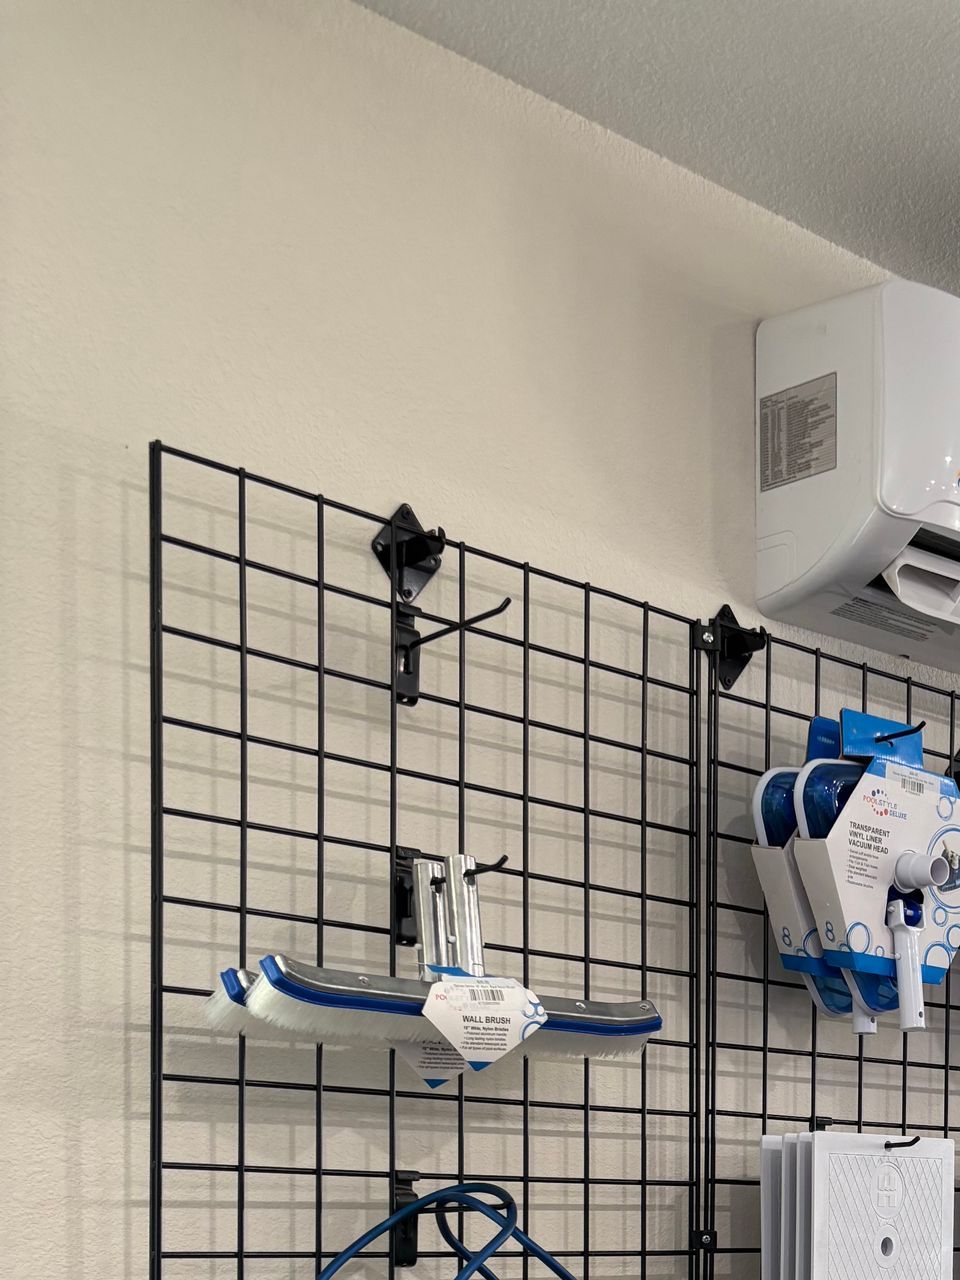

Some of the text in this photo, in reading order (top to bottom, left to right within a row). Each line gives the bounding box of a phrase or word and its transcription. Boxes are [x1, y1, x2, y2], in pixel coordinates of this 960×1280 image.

[889, 808, 907, 820] DELUXE
[849, 821, 890, 838] TRANSPARENT
[849, 830, 883, 844] VINYL LINER
[848, 838, 889, 855] VACUUM HEAD
[462, 1015, 511, 1025] WALL BRUSH
